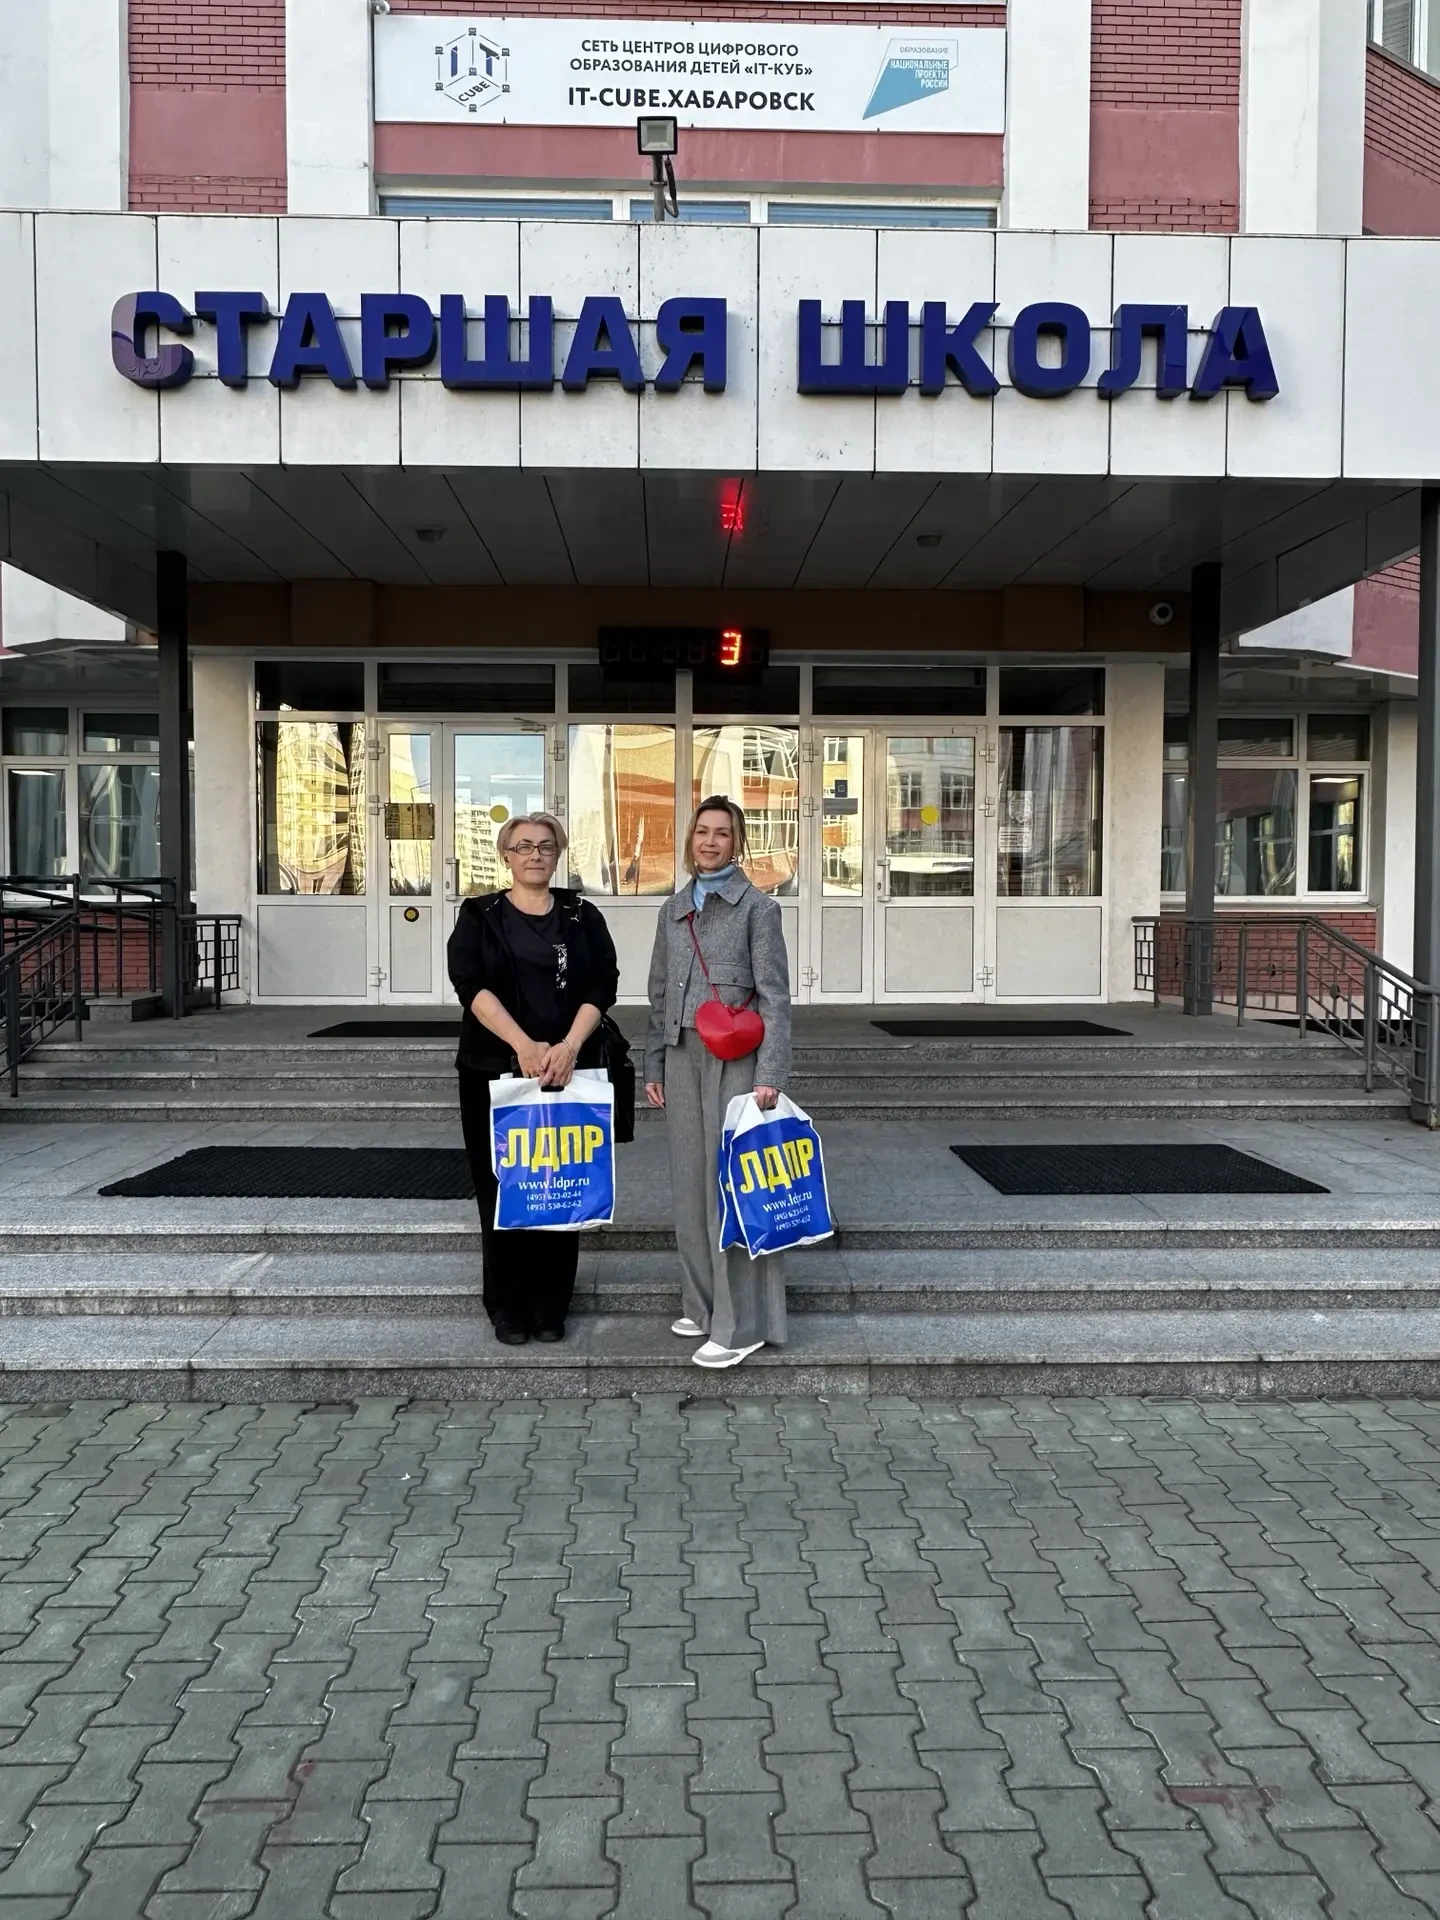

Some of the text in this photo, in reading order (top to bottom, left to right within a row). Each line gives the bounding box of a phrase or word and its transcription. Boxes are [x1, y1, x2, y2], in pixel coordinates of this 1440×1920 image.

[581, 39, 799, 57] СЕТЬ ЦЕНТРОВ ЦИФРОВОГО
[570, 58, 813, 76] ОБРАЗОВАНИЯ ДЕТЕЙ «IT-КУБ»
[890, 59, 948, 70] НАЦИОНАЛЬНЫЕ
[914, 69, 948, 79] ПРОЕКТЫ
[458, 81, 491, 102] CUBE
[920, 79, 948, 89] РОССИИ
[568, 87, 815, 111] IT-CUBE.ХАБАРОВСК
[111, 290, 1280, 402] СТАРШАЯ ШКОЛА
[720, 631, 742, 666] 3
[500, 1125, 604, 1173] ЛДПР
[740, 1138, 814, 1193] ЛДПР
[518, 1176, 590, 1191] www.ldpr.ru
[526, 1193, 546, 1201] (495)
[526, 1203, 546, 1212] (495)
